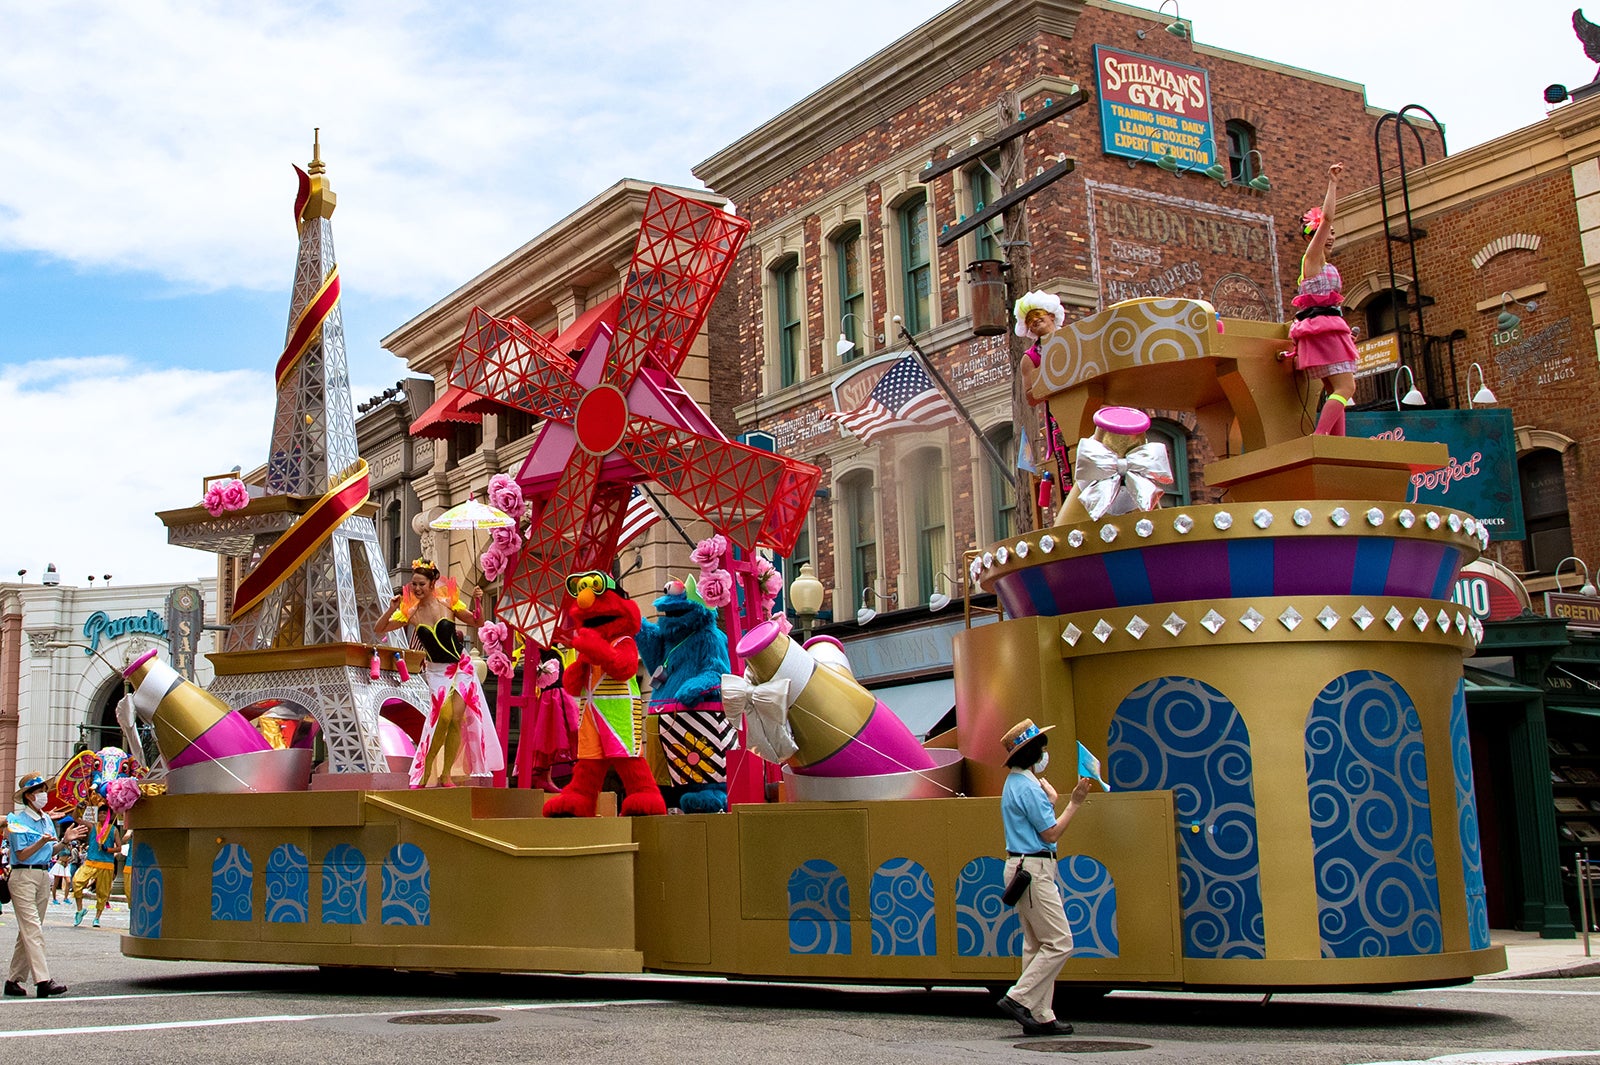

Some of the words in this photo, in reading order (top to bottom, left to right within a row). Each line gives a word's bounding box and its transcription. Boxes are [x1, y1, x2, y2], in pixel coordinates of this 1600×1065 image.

[1104, 57, 1205, 109] STILLMAN'S
[1128, 83, 1186, 114] GYM
[1110, 104, 1154, 123] TRAINING
[1156, 114, 1178, 129] HERE
[1114, 132, 1149, 152] EXPERT
[1119, 120, 1161, 139] LEADING
[1163, 130, 1201, 148] BOXERS
[1102, 199, 1189, 246] UNION
[1193, 217, 1267, 262] NEWS
[1107, 261, 1203, 300] NEWSPAPERS
[991, 334, 1006, 349] PM
[956, 368, 1004, 393] ADMISSION
[1538, 374, 1552, 385] ALL
[1553, 367, 1576, 381] AGES
[1546, 677, 1573, 689] NEWS
